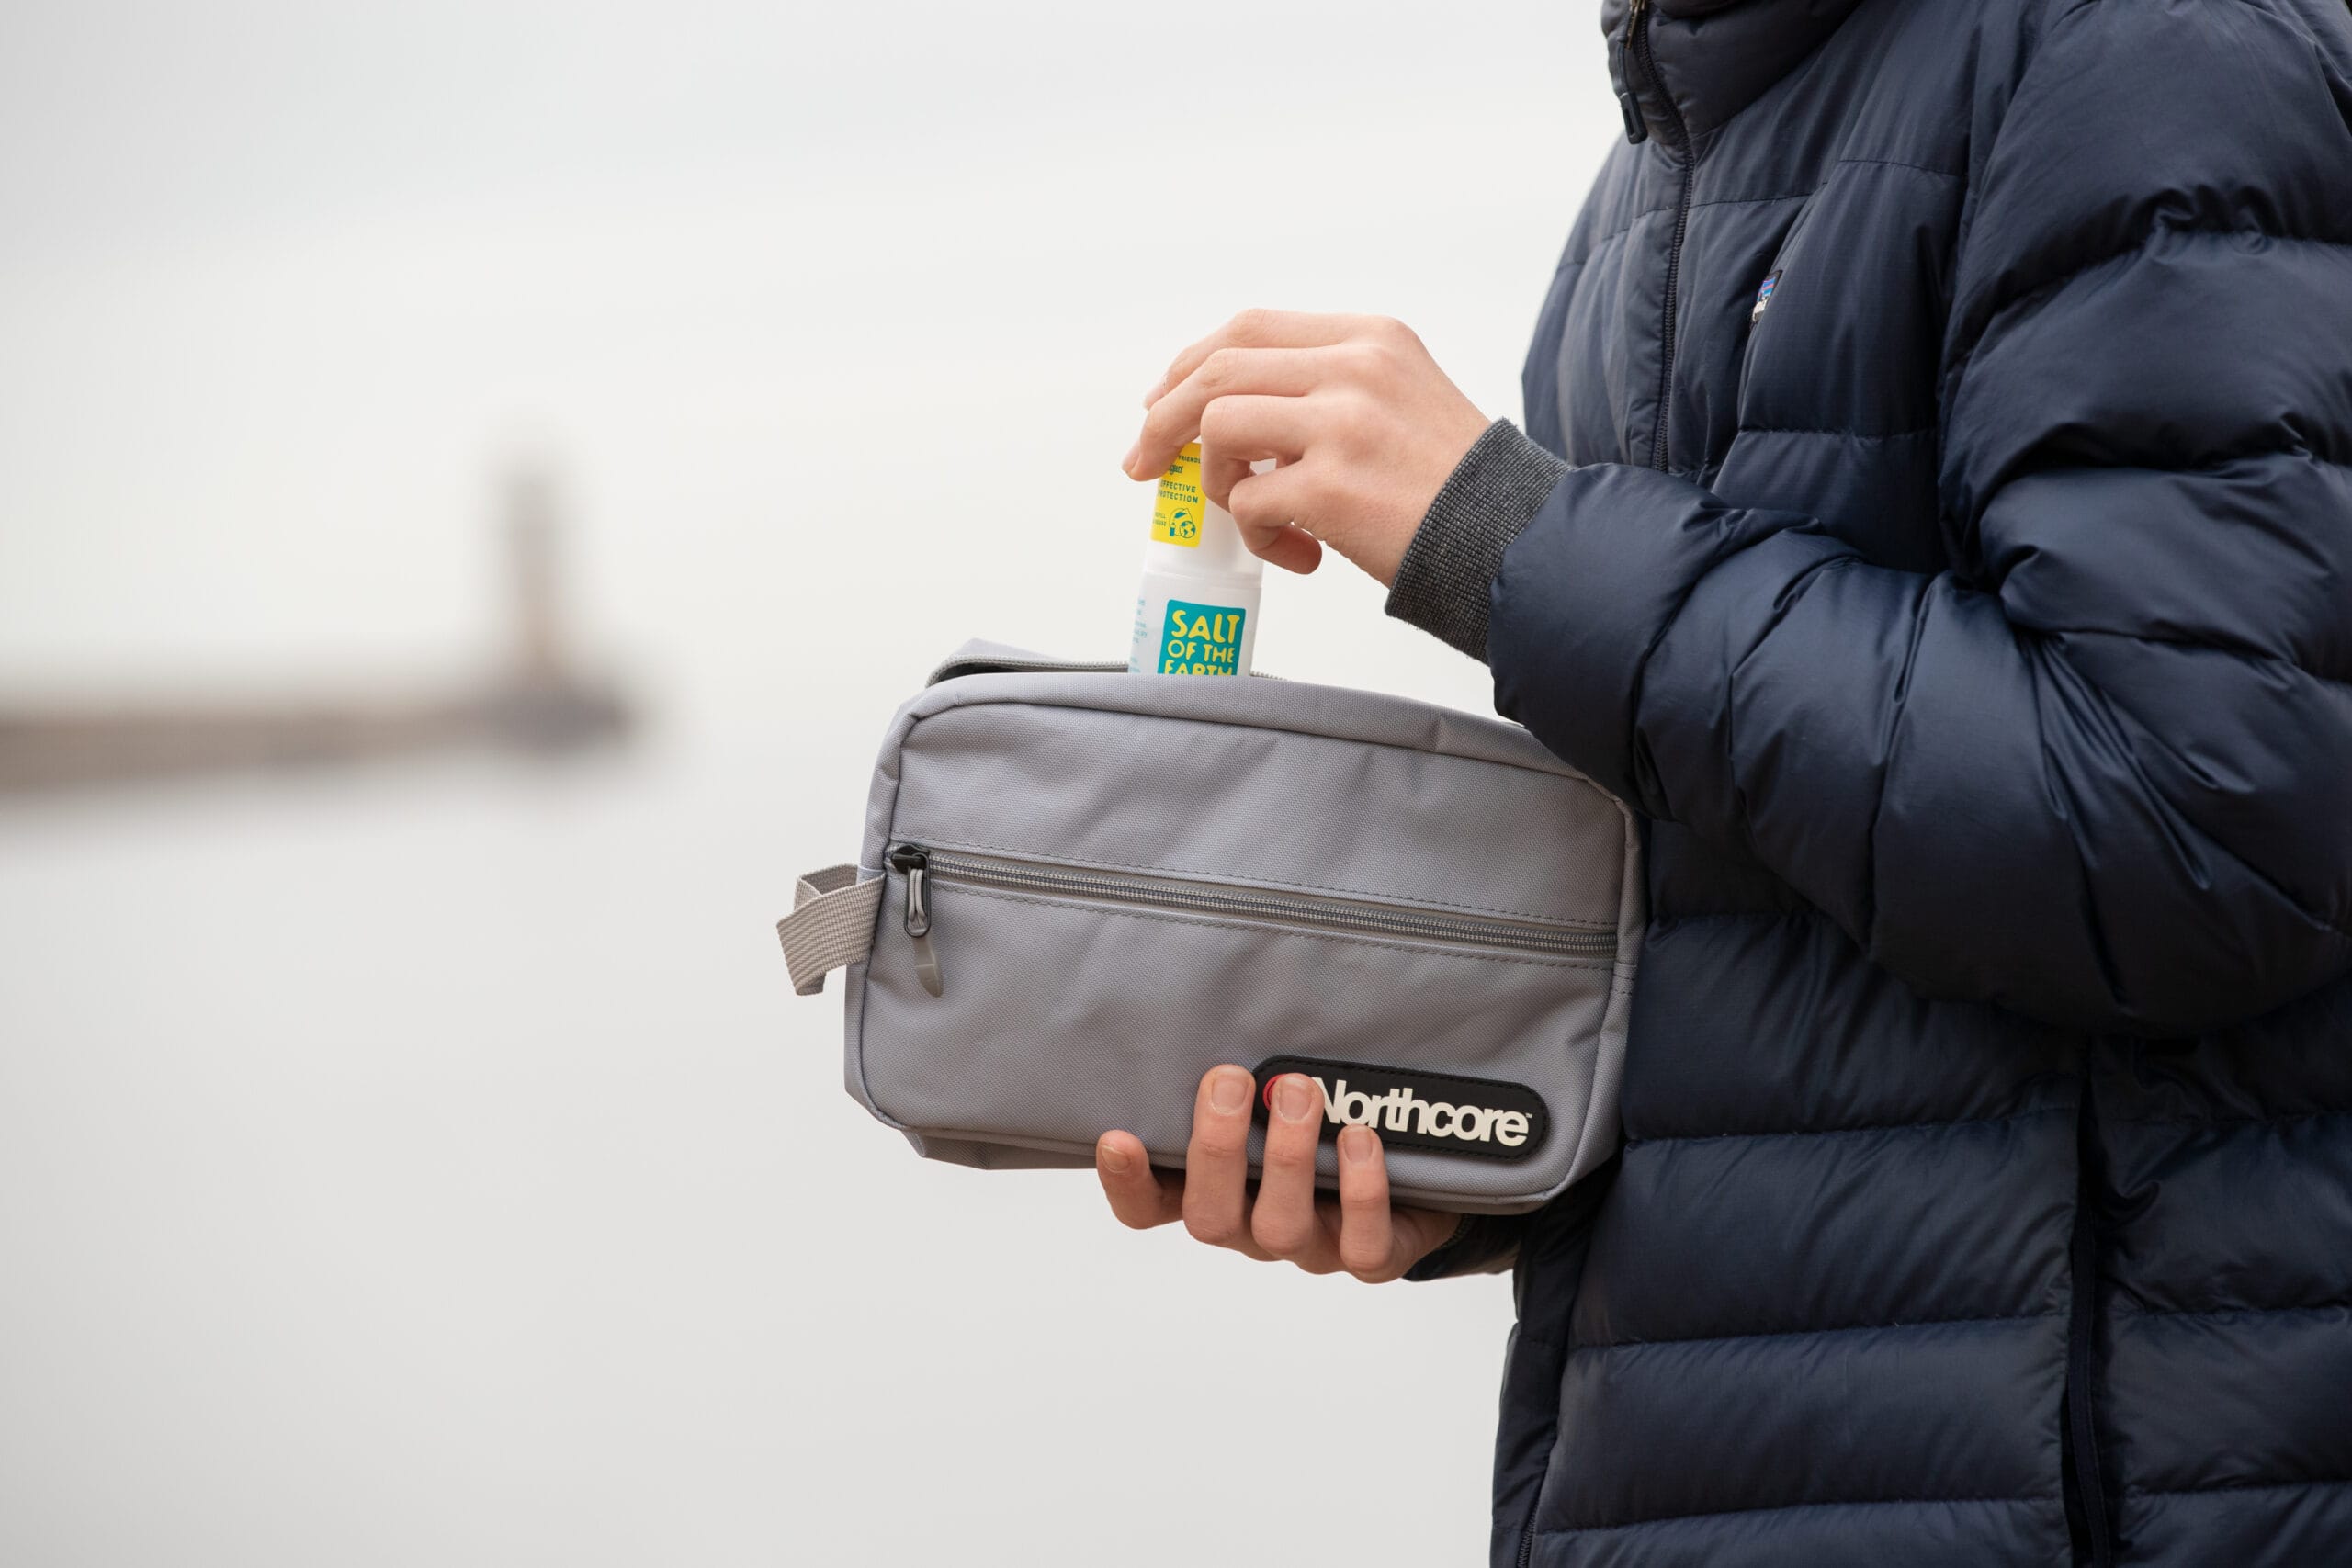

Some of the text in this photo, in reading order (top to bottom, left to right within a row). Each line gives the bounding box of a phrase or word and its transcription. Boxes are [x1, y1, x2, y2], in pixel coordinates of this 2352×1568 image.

[1170, 610, 1240, 643] SALT
[1167, 640, 1236, 662] OF THE
[1311, 1077, 1529, 1146] Northcore
